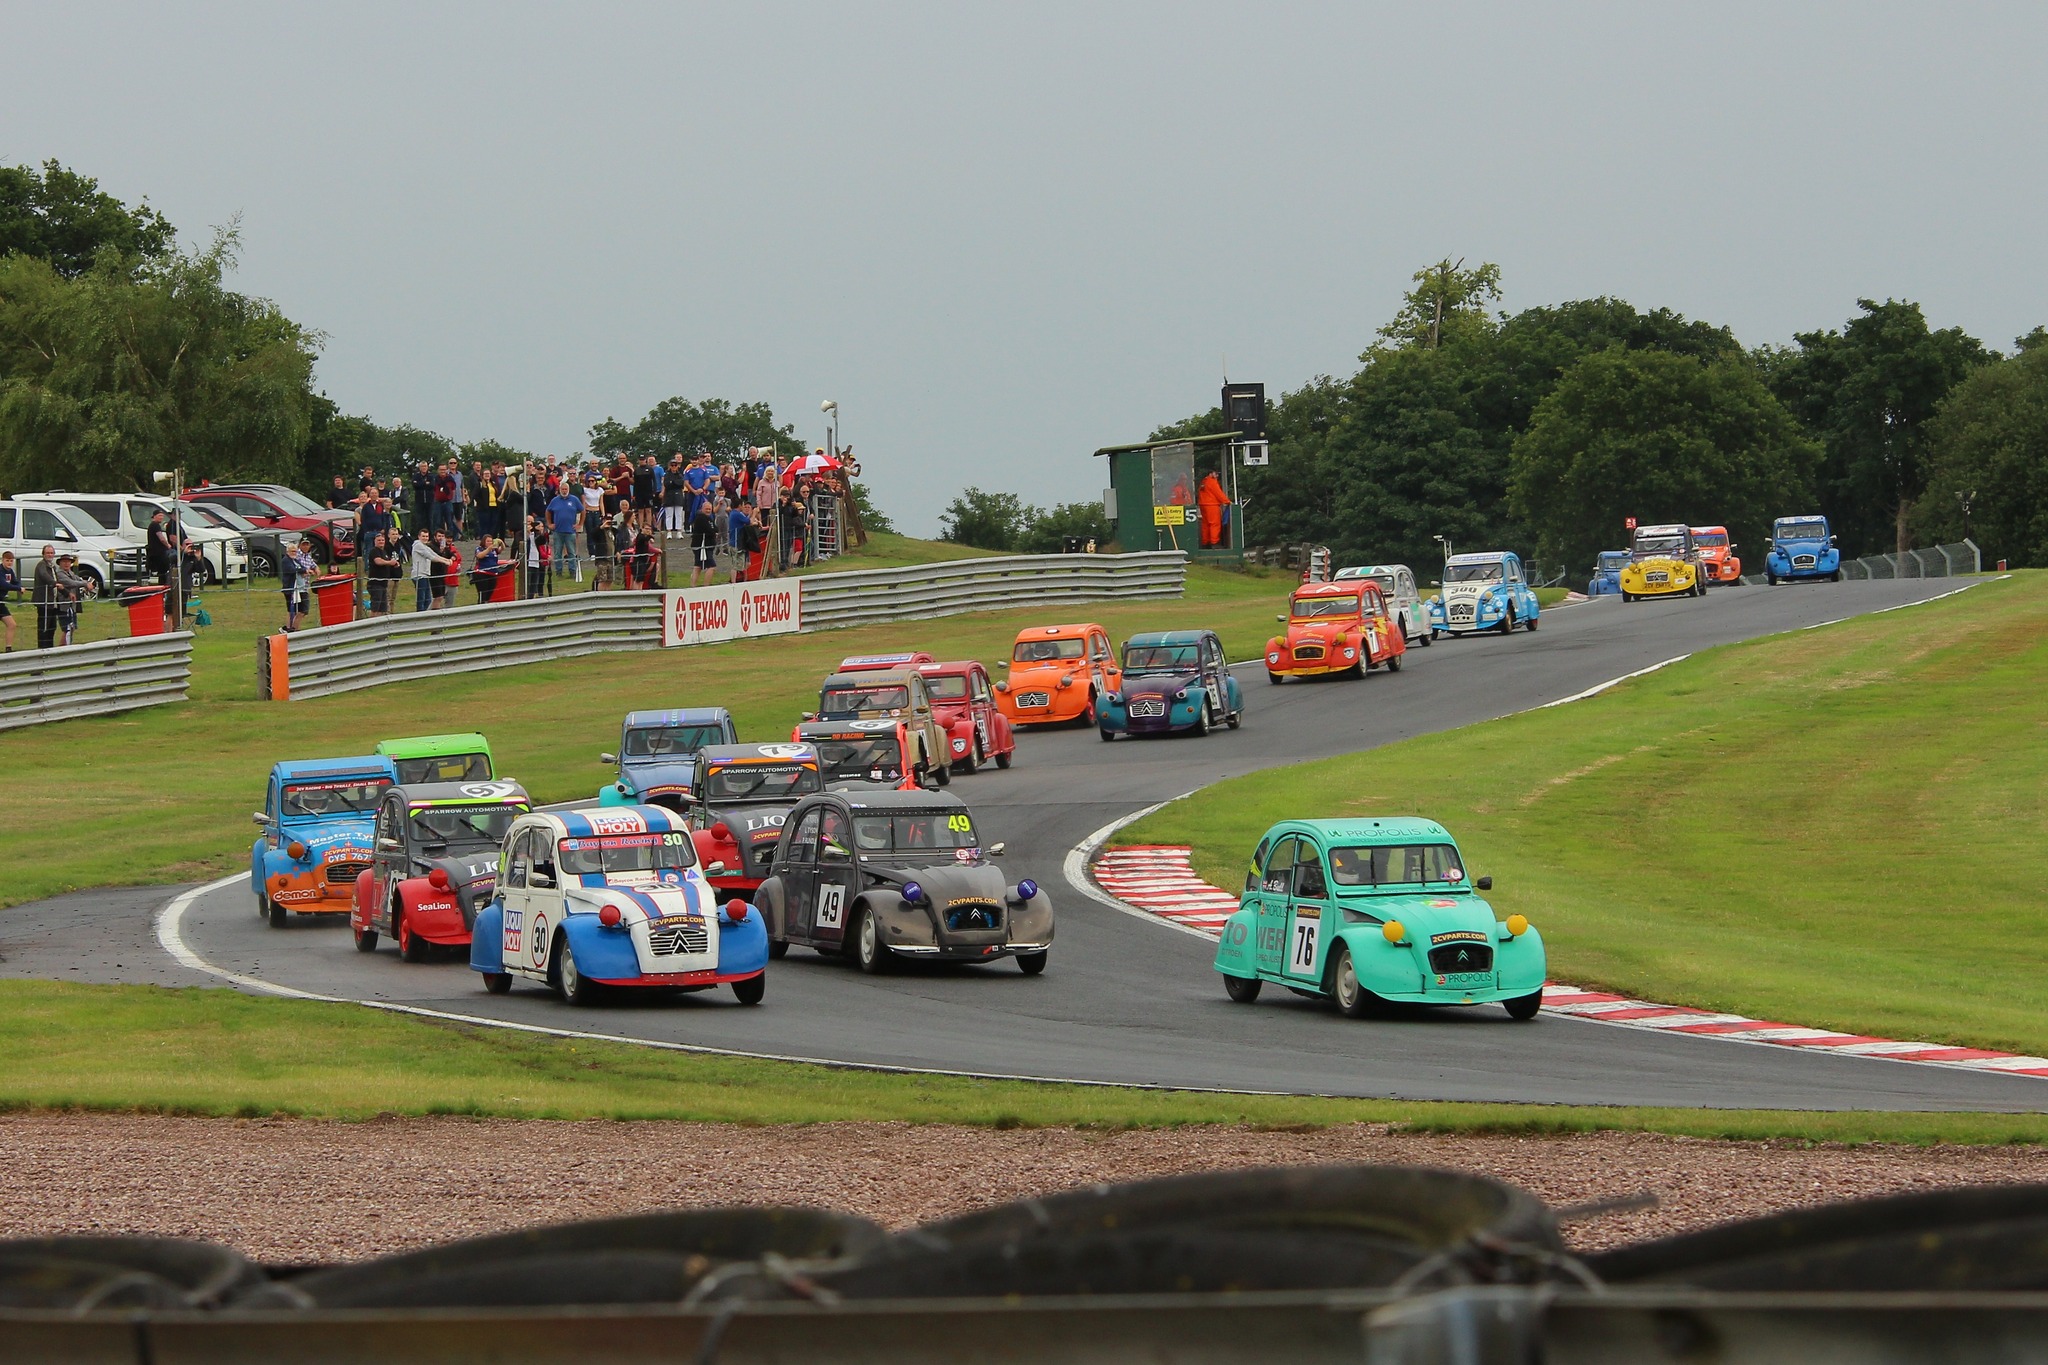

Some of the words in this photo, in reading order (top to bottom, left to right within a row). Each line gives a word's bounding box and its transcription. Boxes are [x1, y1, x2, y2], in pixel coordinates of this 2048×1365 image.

[1186, 509, 1197, 522] 5
[754, 591, 791, 624] TEXACO
[690, 599, 728, 631] TEXACO
[599, 822, 640, 834] MOLY
[948, 814, 970, 832] 49
[309, 832, 352, 845] Master
[1346, 828, 1421, 837] PROPOLIS
[621, 834, 658, 845] Racing
[662, 833, 683, 846] 30
[328, 854, 347, 863] CYS
[273, 889, 317, 901] demon
[948, 897, 998, 906] 2CVPARTS.COM
[418, 902, 451, 911] SeaLion
[822, 892, 839, 922] 49
[506, 912, 522, 930] LIQUI
[651, 917, 704, 926] 2CVPARTS.COM
[534, 926, 546, 953] 30
[1226, 922, 1248, 945] TO
[1432, 932, 1486, 943] 2CVPARTS.COM
[505, 932, 520, 950] MOLY
[1296, 926, 1315, 966] 76
[1449, 972, 1492, 983] PROPOLIS
